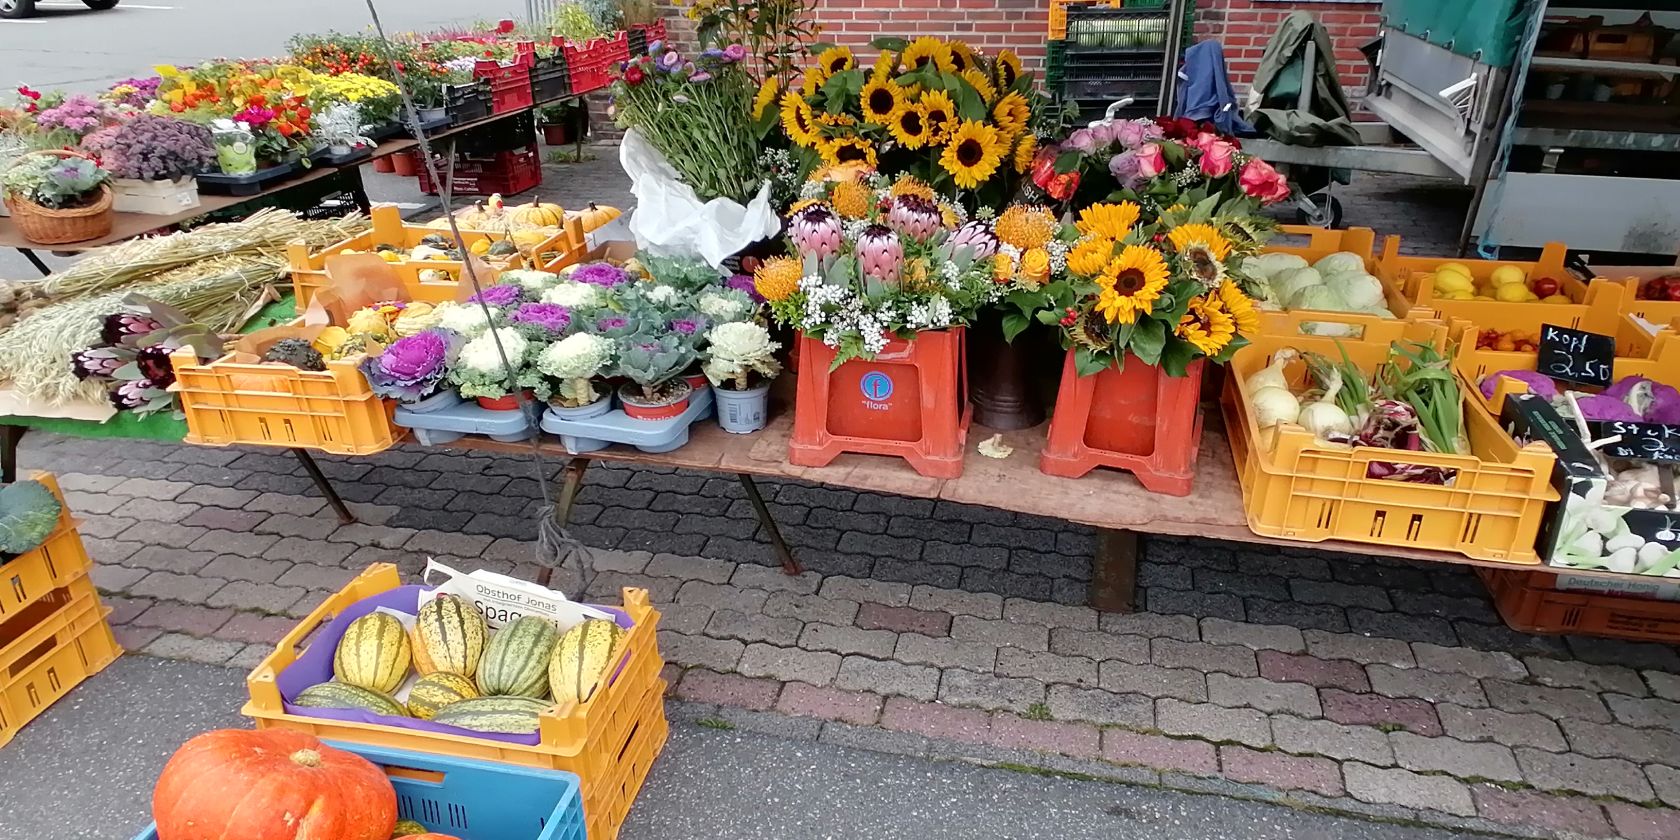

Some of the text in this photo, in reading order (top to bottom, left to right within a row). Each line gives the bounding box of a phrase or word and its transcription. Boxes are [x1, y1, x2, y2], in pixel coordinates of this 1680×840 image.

[1550, 350, 1610, 380] 2,50
[476, 584, 522, 601] Obsthof
[526, 597, 557, 612] Jonas
